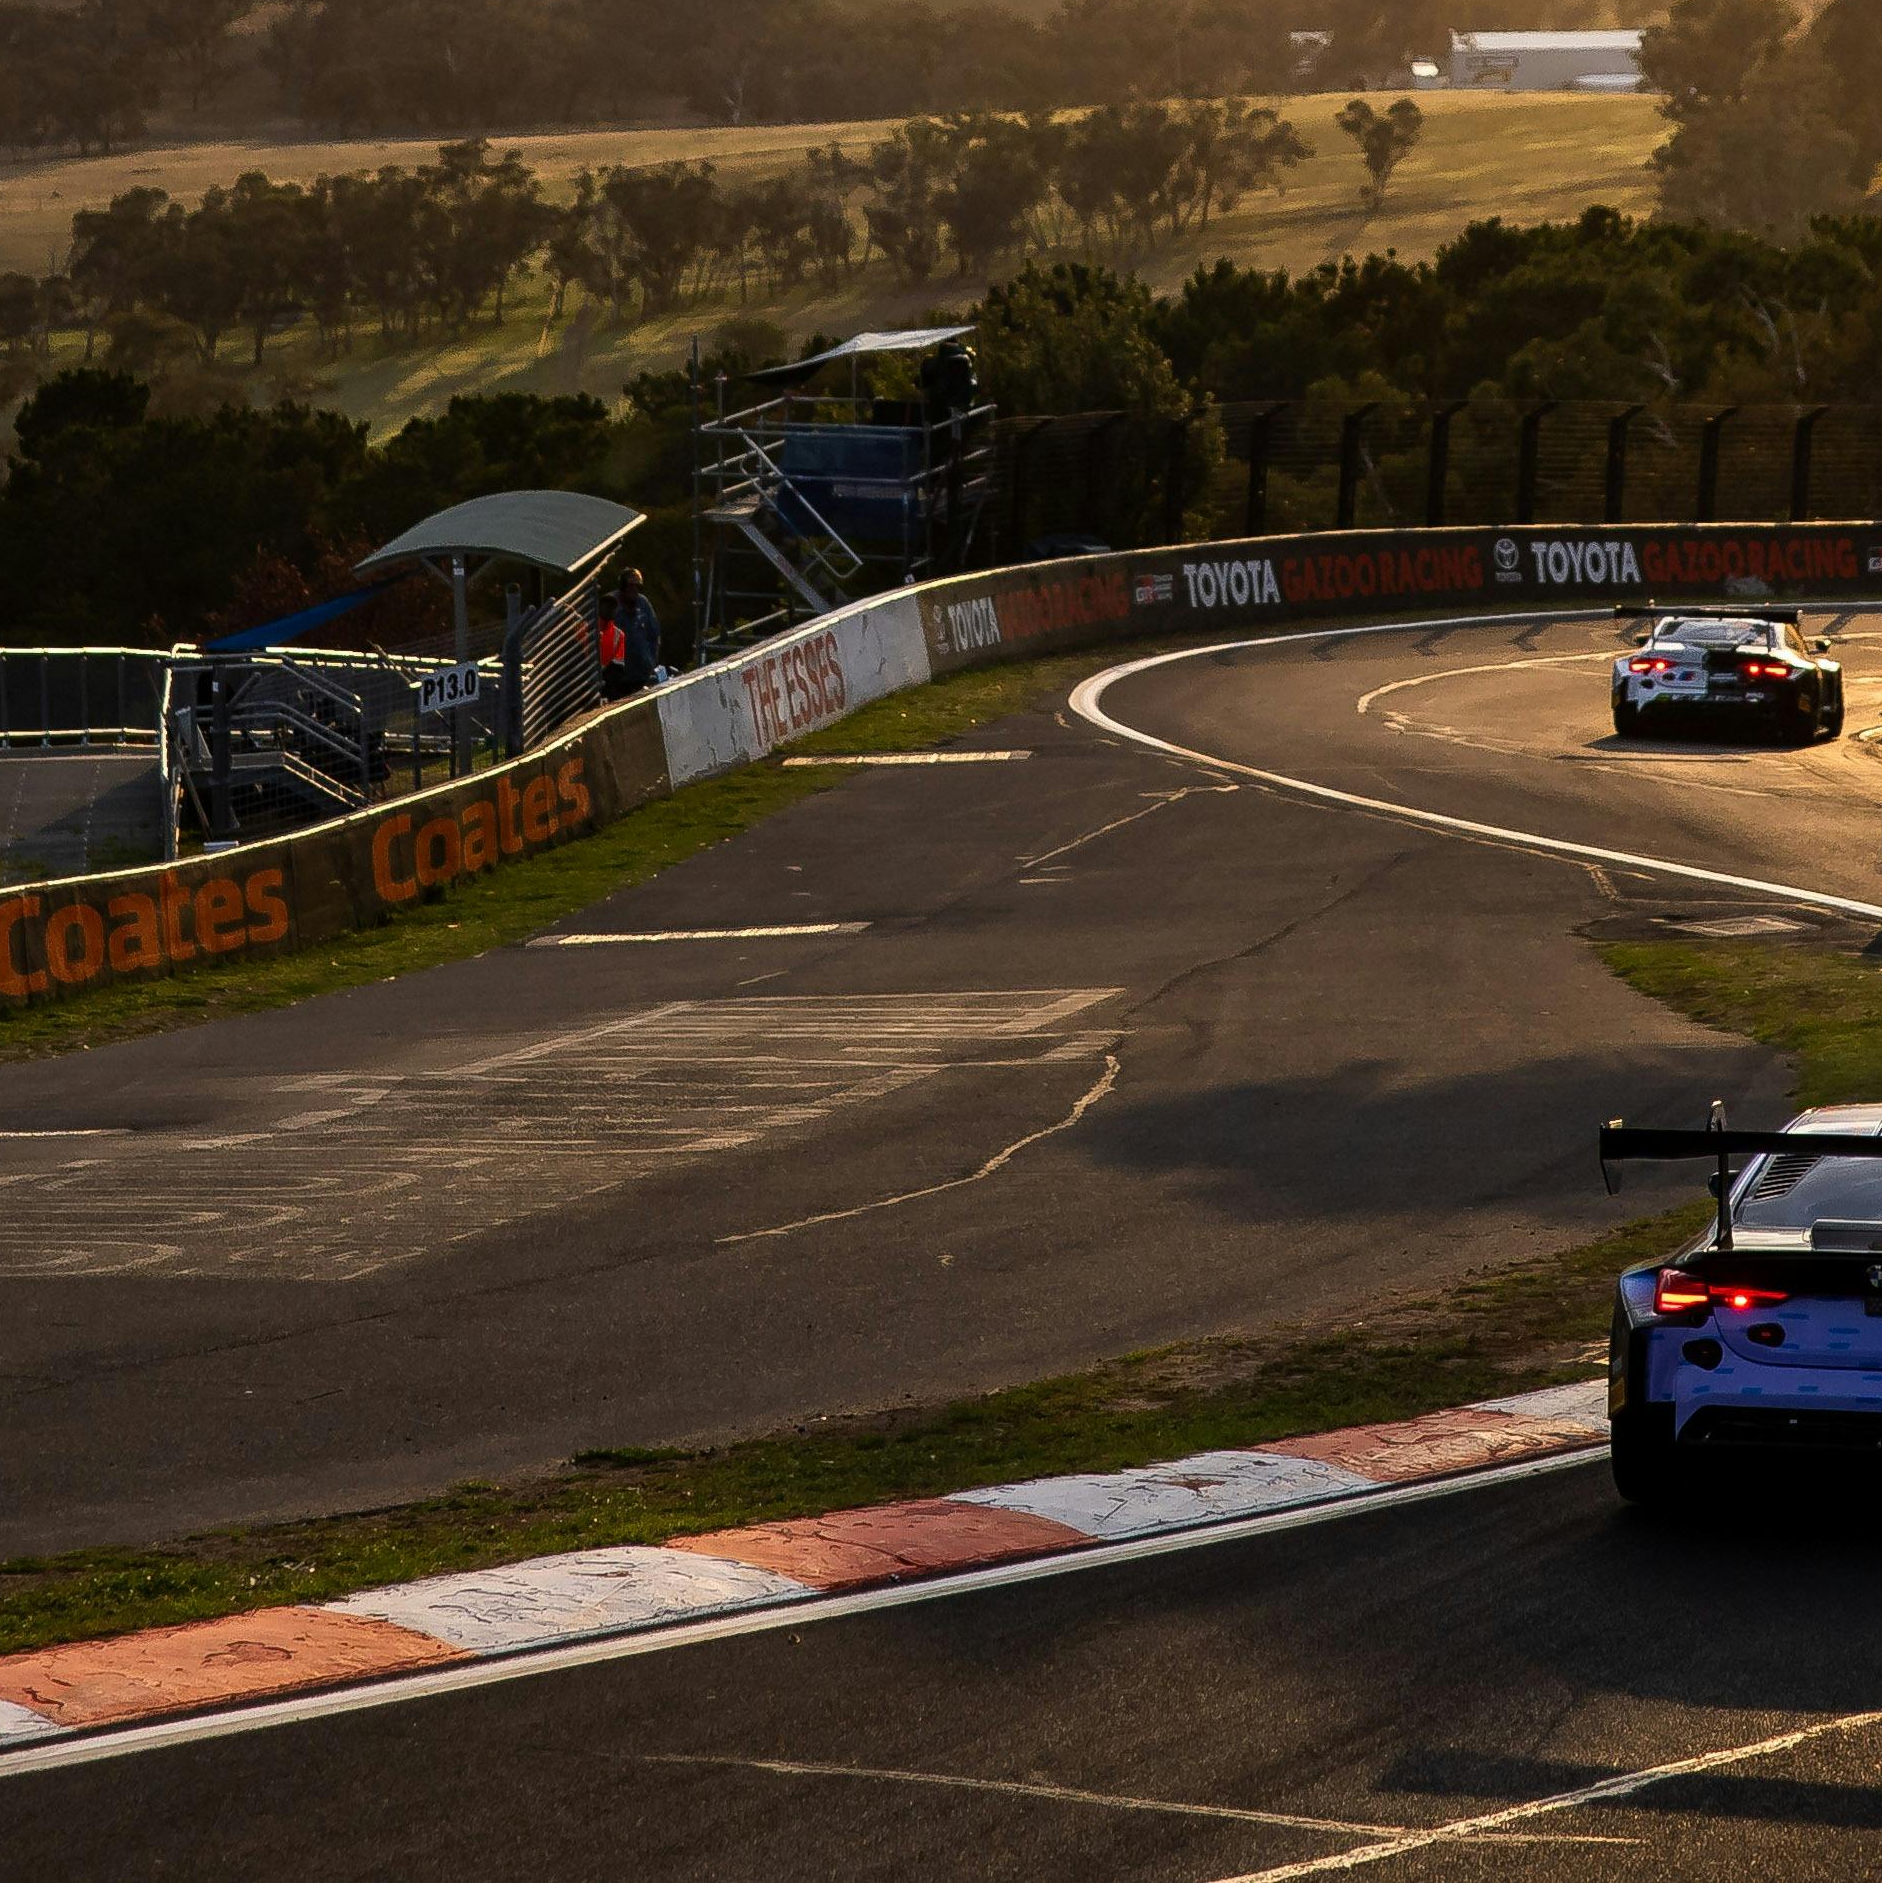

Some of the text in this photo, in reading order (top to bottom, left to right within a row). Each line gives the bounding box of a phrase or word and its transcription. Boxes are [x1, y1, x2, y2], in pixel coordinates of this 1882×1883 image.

[1183, 559, 1281, 608] TOYOTA
[1282, 553, 1377, 603] GAZOO
[1378, 545, 1484, 595] RACING
[1531, 541, 1642, 584] TOYOTA
[1643, 540, 1744, 583] GAZOO
[1747, 536, 1859, 581] RACING
[947, 596, 1002, 653] TOYOTA
[422, 669, 477, 706] P13.0
[741, 630, 845, 748] THE ESSES
[372, 756, 590, 903] Coates
